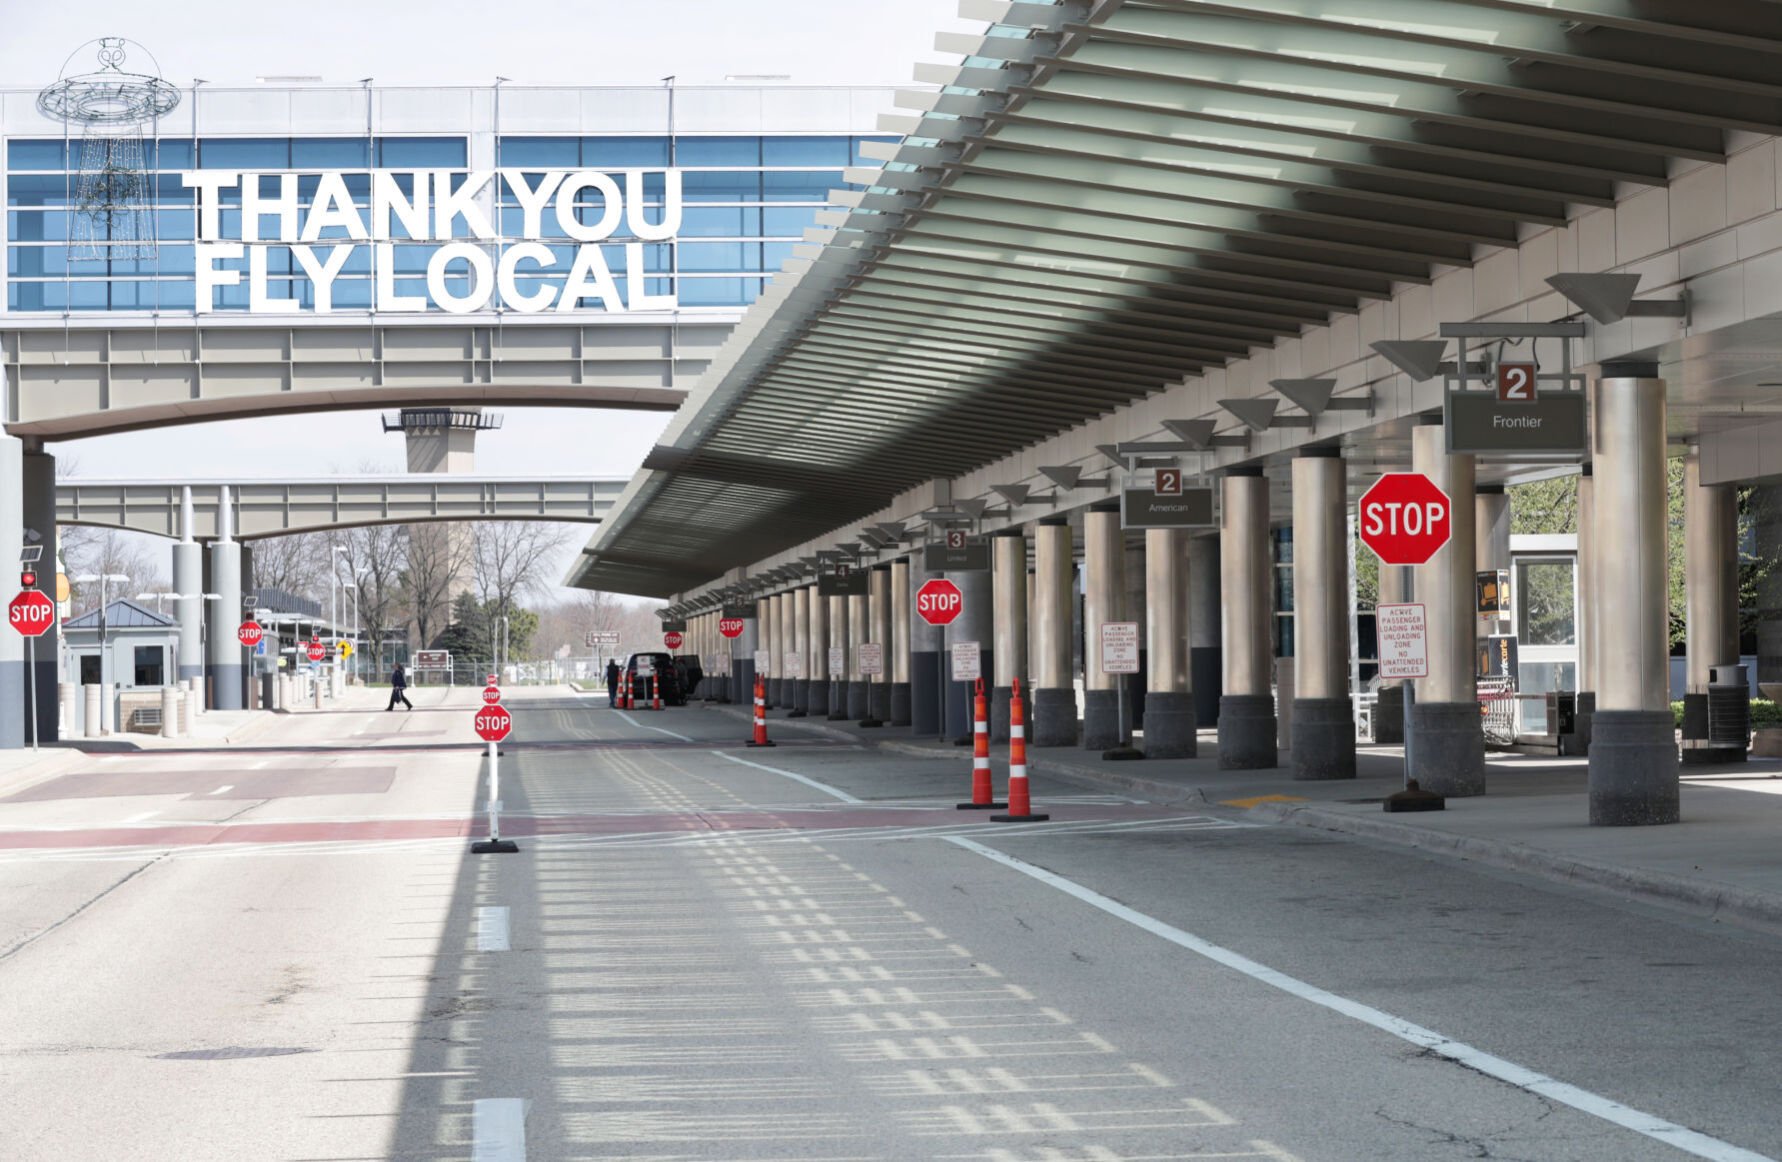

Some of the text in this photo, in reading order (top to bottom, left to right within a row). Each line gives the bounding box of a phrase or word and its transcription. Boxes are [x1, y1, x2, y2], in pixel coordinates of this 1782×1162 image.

[182, 171, 682, 241] THANK YOU
[196, 242, 678, 314] FLY LOCAL
[1506, 368, 1527, 399] 2
[1493, 415, 1543, 428] Frontier
[1162, 473, 1175, 491] 2
[1149, 504, 1188, 512] American
[1365, 502, 1445, 536] STOP
[951, 533, 962, 547] 3
[920, 593, 959, 611] STOP
[11, 605, 51, 622] STOP
[720, 621, 743, 631] STOP
[239, 628, 260, 639] STOP
[665, 636, 682, 644] STOP
[308, 648, 324, 656] STOP
[1383, 658, 1424, 666] UNATTENDED
[483, 691, 500, 699] STOP
[476, 716, 509, 730] STOP
